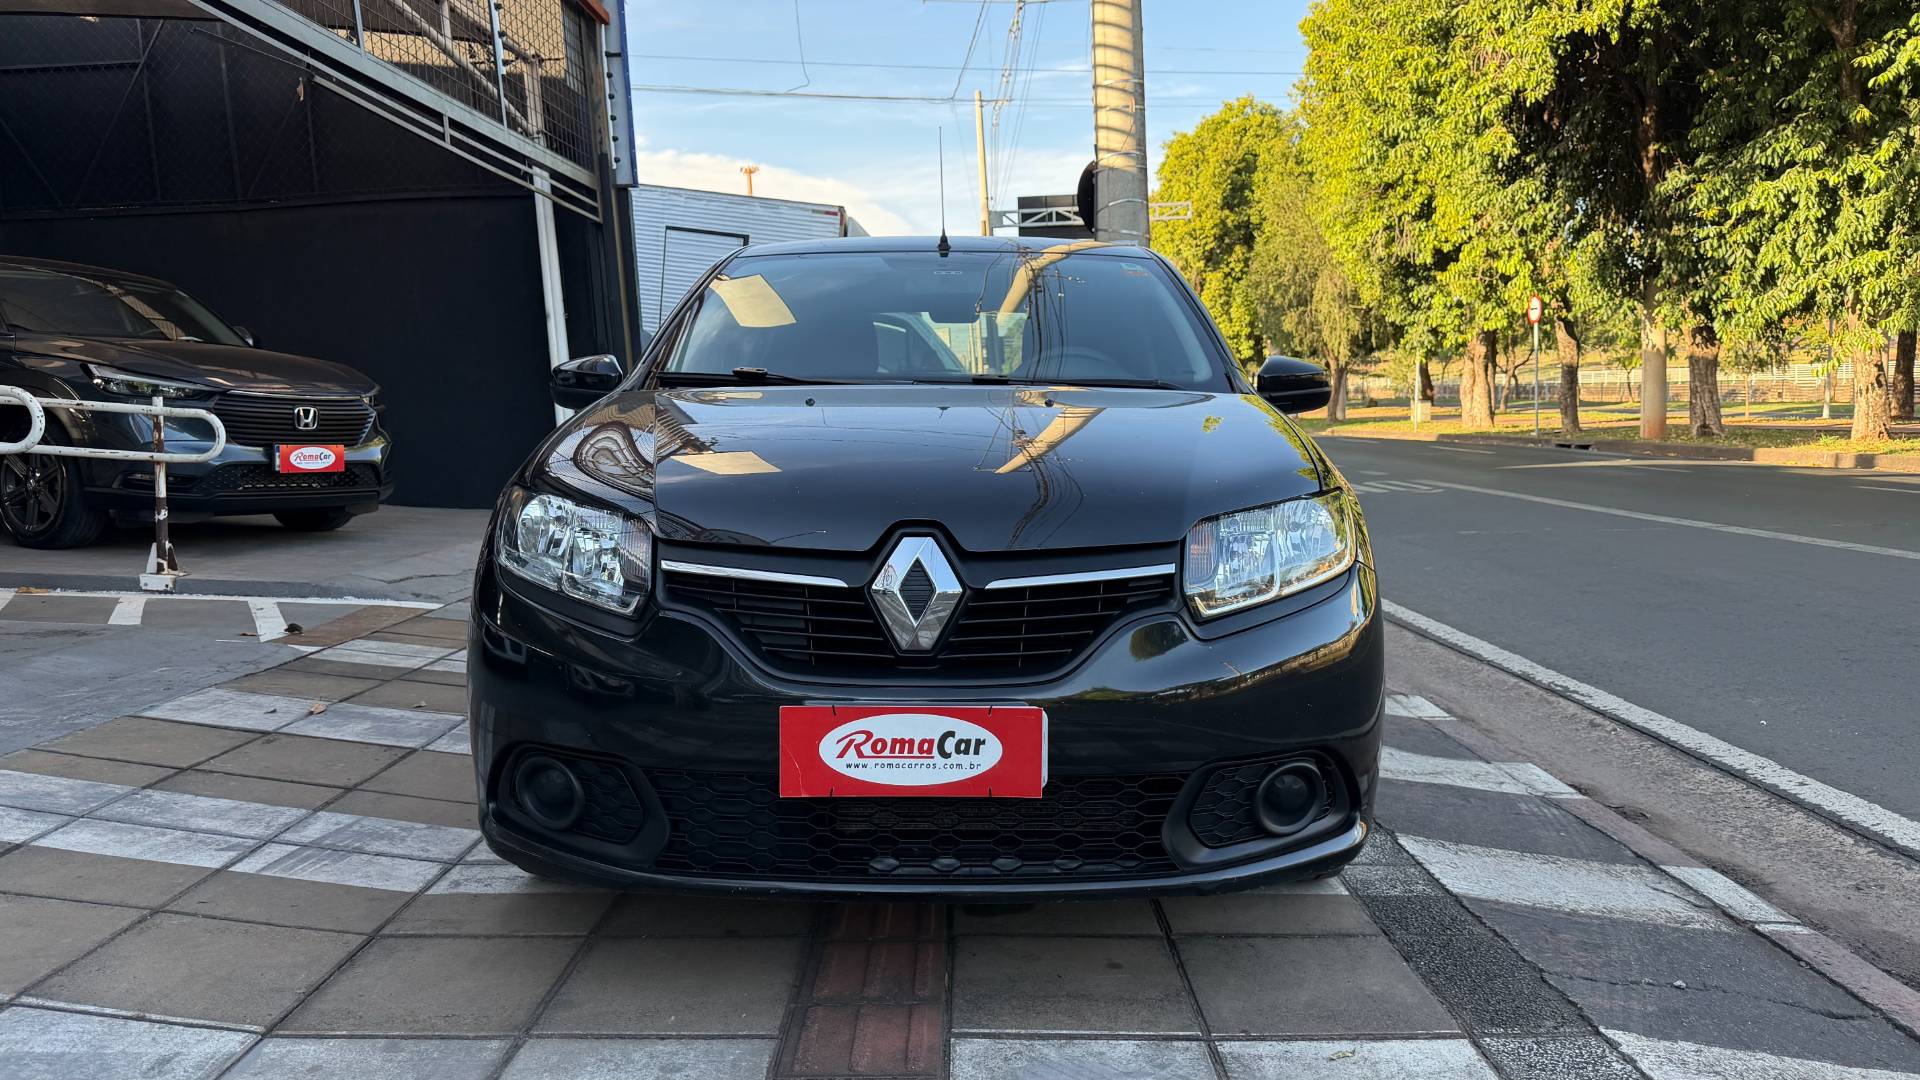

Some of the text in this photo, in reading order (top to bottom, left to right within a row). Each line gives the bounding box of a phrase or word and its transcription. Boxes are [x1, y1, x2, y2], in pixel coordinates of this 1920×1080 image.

[294, 452, 331, 461] RomaCar
[836, 730, 986, 759] RomaCar
[846, 761, 981, 770] www.romacarros.com.br
